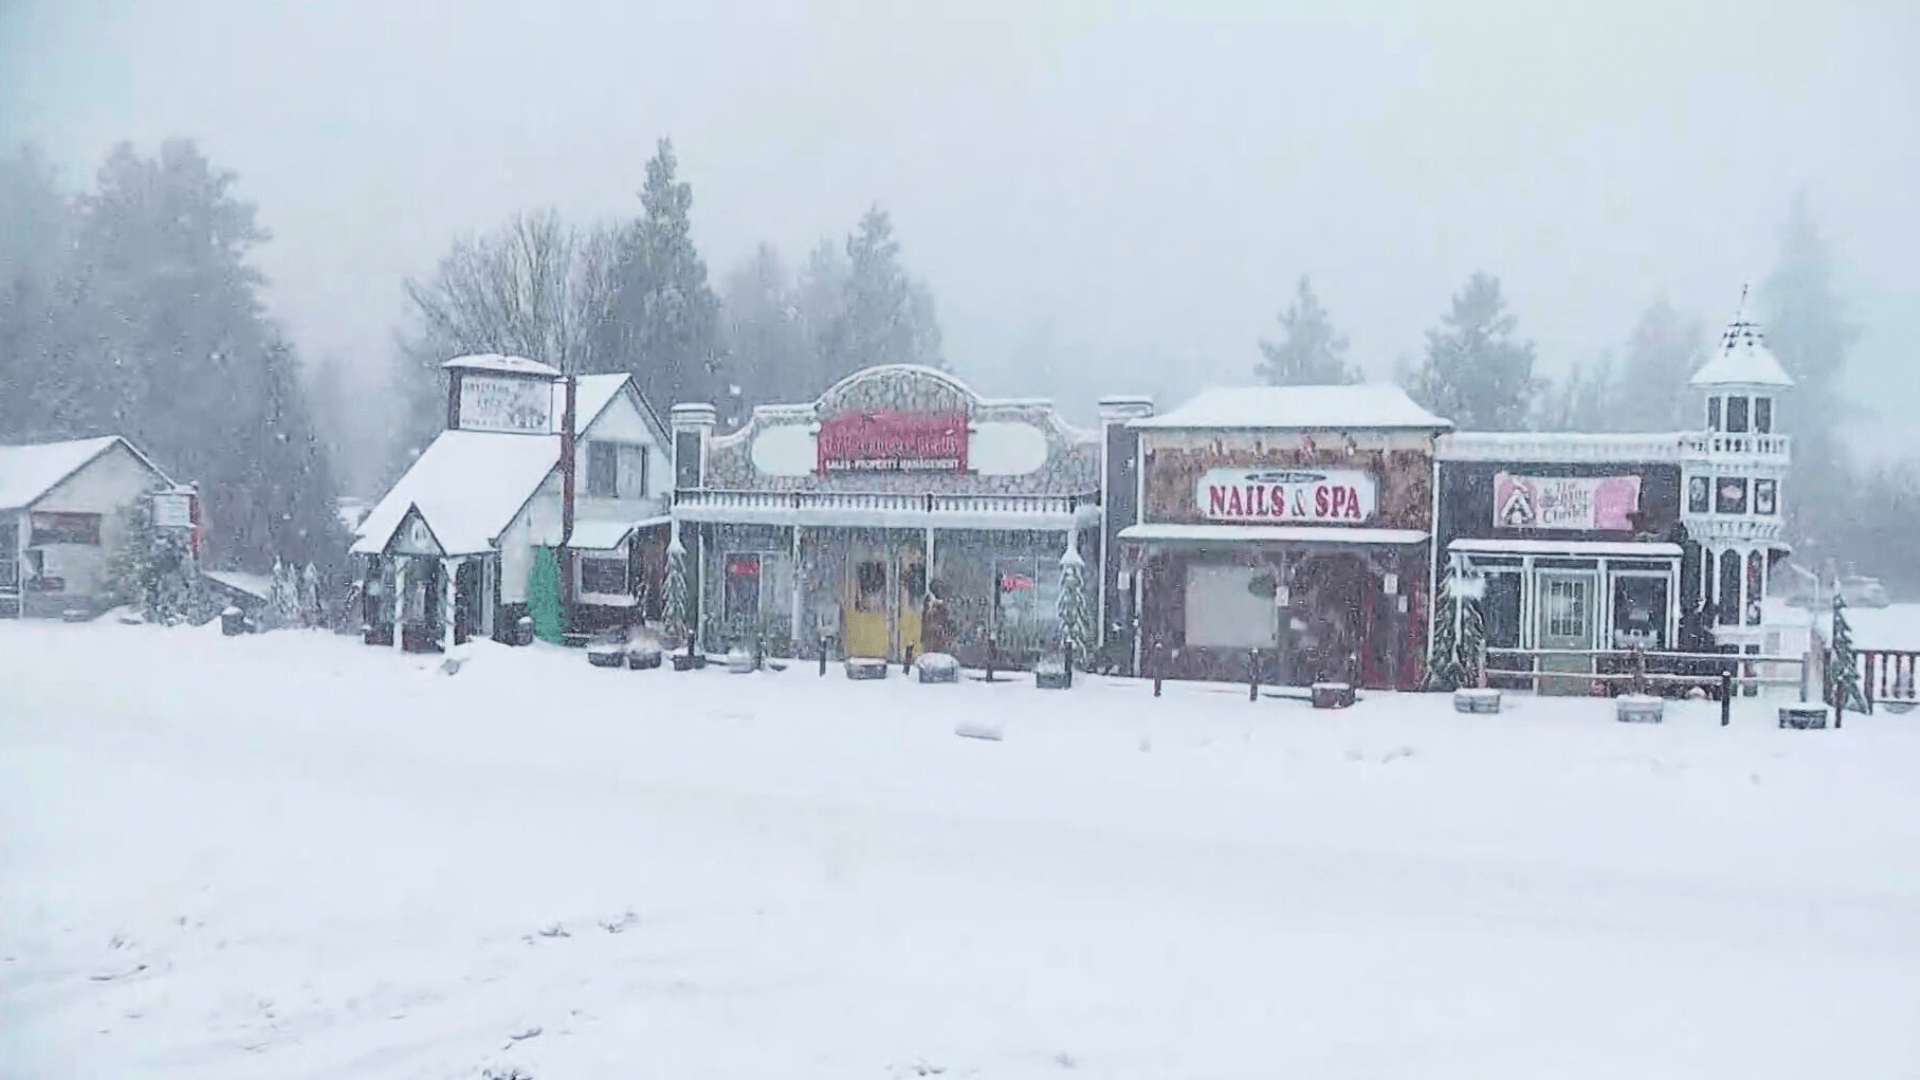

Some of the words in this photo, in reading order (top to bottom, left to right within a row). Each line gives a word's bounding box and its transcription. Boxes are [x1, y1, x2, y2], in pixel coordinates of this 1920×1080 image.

[900, 458, 959, 471] MANAGEMENT
[1209, 485, 1285, 517] NAILS
[1291, 488, 1306, 517] &
[1315, 486, 1361, 519] SPA
